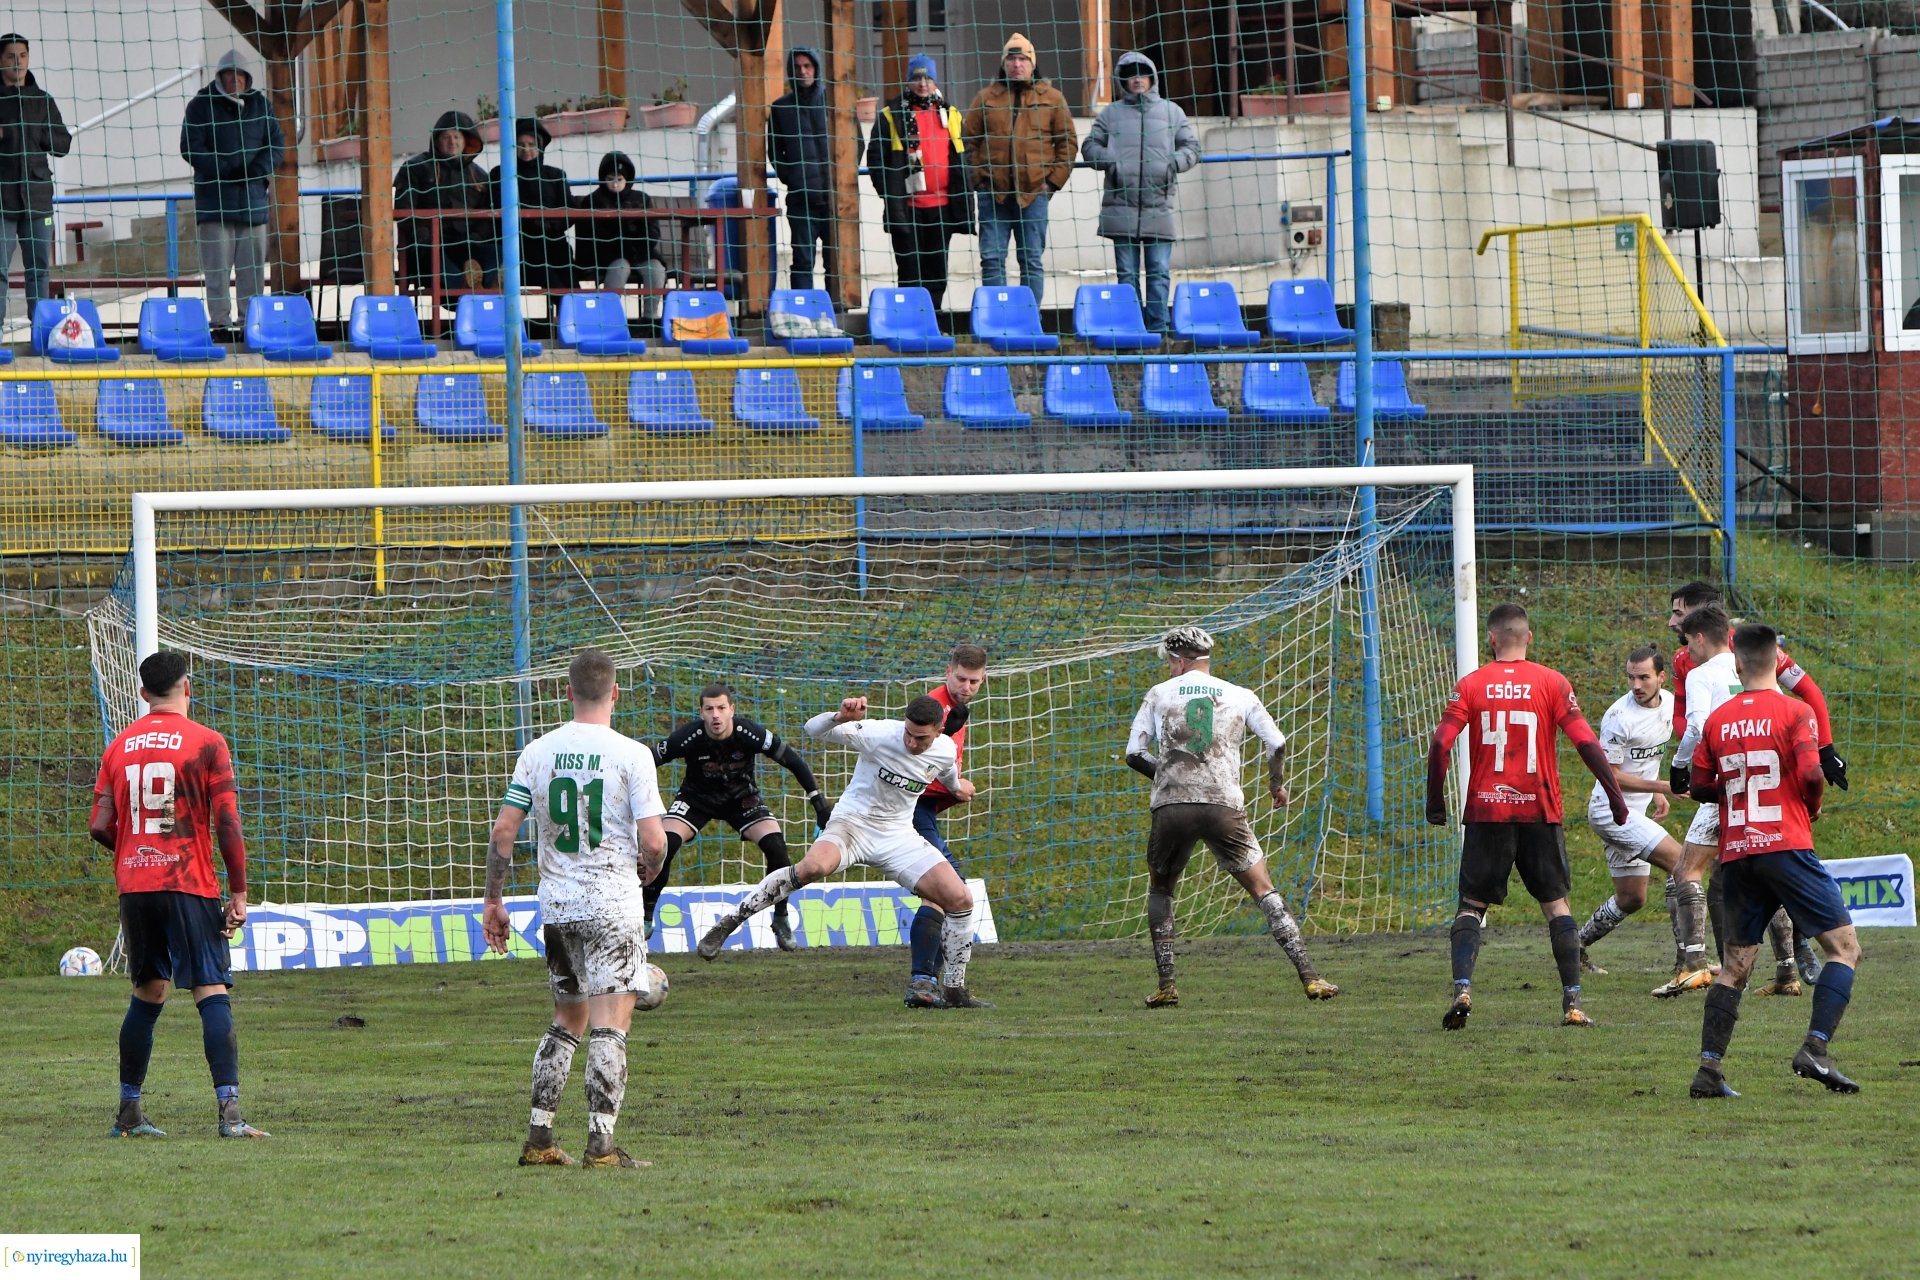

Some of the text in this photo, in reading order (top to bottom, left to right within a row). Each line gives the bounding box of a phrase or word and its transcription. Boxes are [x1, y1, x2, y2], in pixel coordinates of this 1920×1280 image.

[1179, 685, 1223, 697] BORSOS
[124, 731, 183, 753] GRESÓ
[1185, 697, 1214, 753] 9
[1481, 710, 1538, 774] 47
[1721, 719, 1772, 742] PATAKI
[554, 753, 604, 773] KISS M.
[125, 762, 176, 835] 19
[668, 800, 691, 816] 95
[1719, 750, 1783, 827] 22
[548, 777, 604, 854] 91
